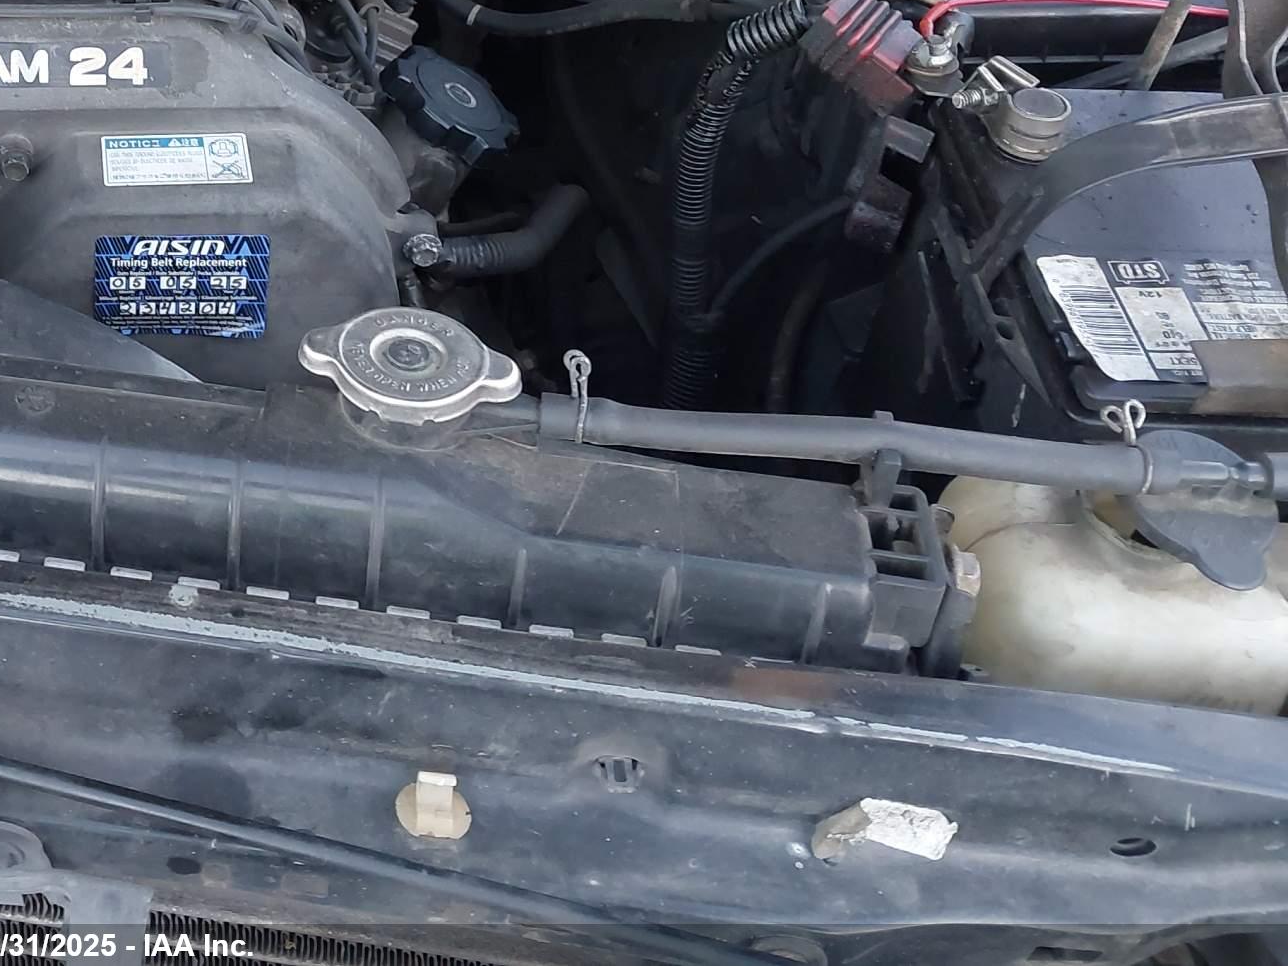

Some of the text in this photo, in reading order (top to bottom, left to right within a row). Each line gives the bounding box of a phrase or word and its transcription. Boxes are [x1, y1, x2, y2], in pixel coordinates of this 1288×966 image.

[68, 47, 148, 87] 24
[133, 239, 226, 256] AISIN
[110, 257, 248, 269] Timing Belt Replacement
[1118, 263, 1162, 280] STD
[111, 277, 245, 289] 05 05 25
